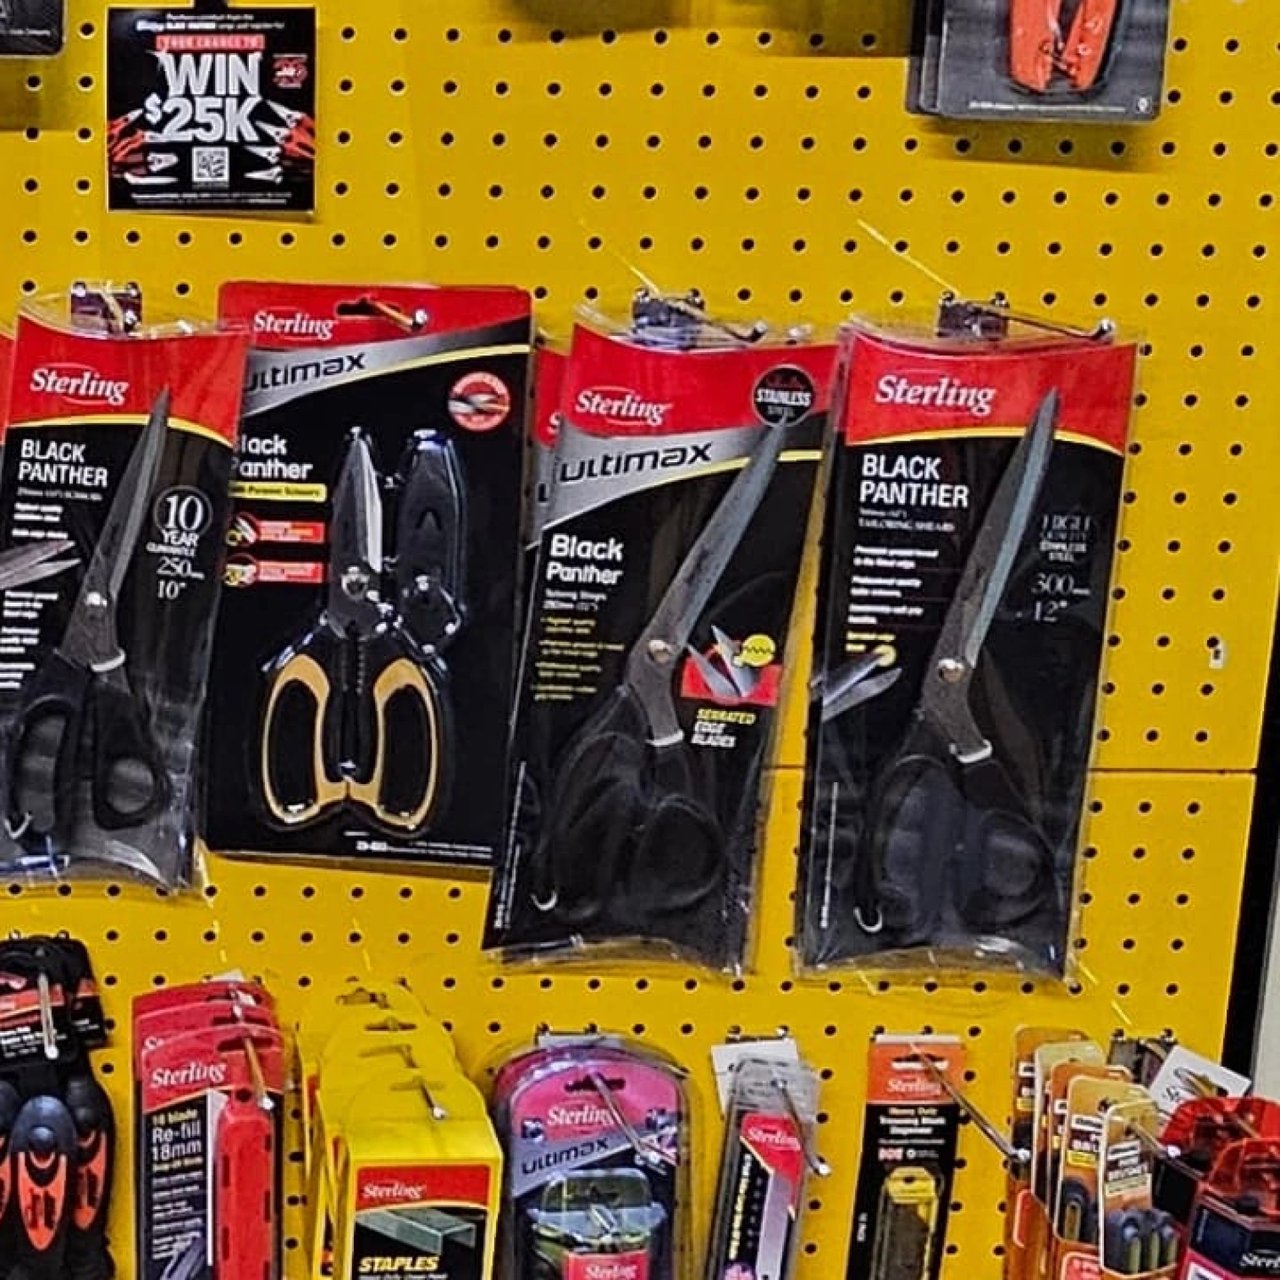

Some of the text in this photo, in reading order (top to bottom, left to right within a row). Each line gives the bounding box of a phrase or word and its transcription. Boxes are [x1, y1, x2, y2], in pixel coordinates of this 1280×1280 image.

[160, 52, 262, 96] WIN
[144, 93, 262, 142] $25K
[253, 310, 335, 341] Sterling
[30, 368, 129, 407] Sterling
[756, 389, 812, 407] STAINLESS
[875, 375, 998, 417] Sterling
[576, 390, 666, 427] Sterling
[21, 438, 86, 463] BLACK
[241, 434, 288, 455] lack
[18, 462, 108, 488] PANTHER
[559, 442, 713, 482] ultimax
[861, 453, 942, 480] BLACK
[859, 479, 969, 508] PANTHER
[166, 495, 204, 532] 10
[161, 529, 200, 547] YEAR
[550, 534, 624, 561] Black
[546, 561, 624, 584] Panther
[697, 708, 756, 725] SERRATED
[151, 1062, 228, 1089] Sterling
[152, 1119, 200, 1144] Re-fill
[152, 1140, 202, 1162] 18mm
[522, 1136, 609, 1174] ultimax
[363, 1182, 426, 1200] Sterling
[359, 1256, 440, 1274] STAPLES
